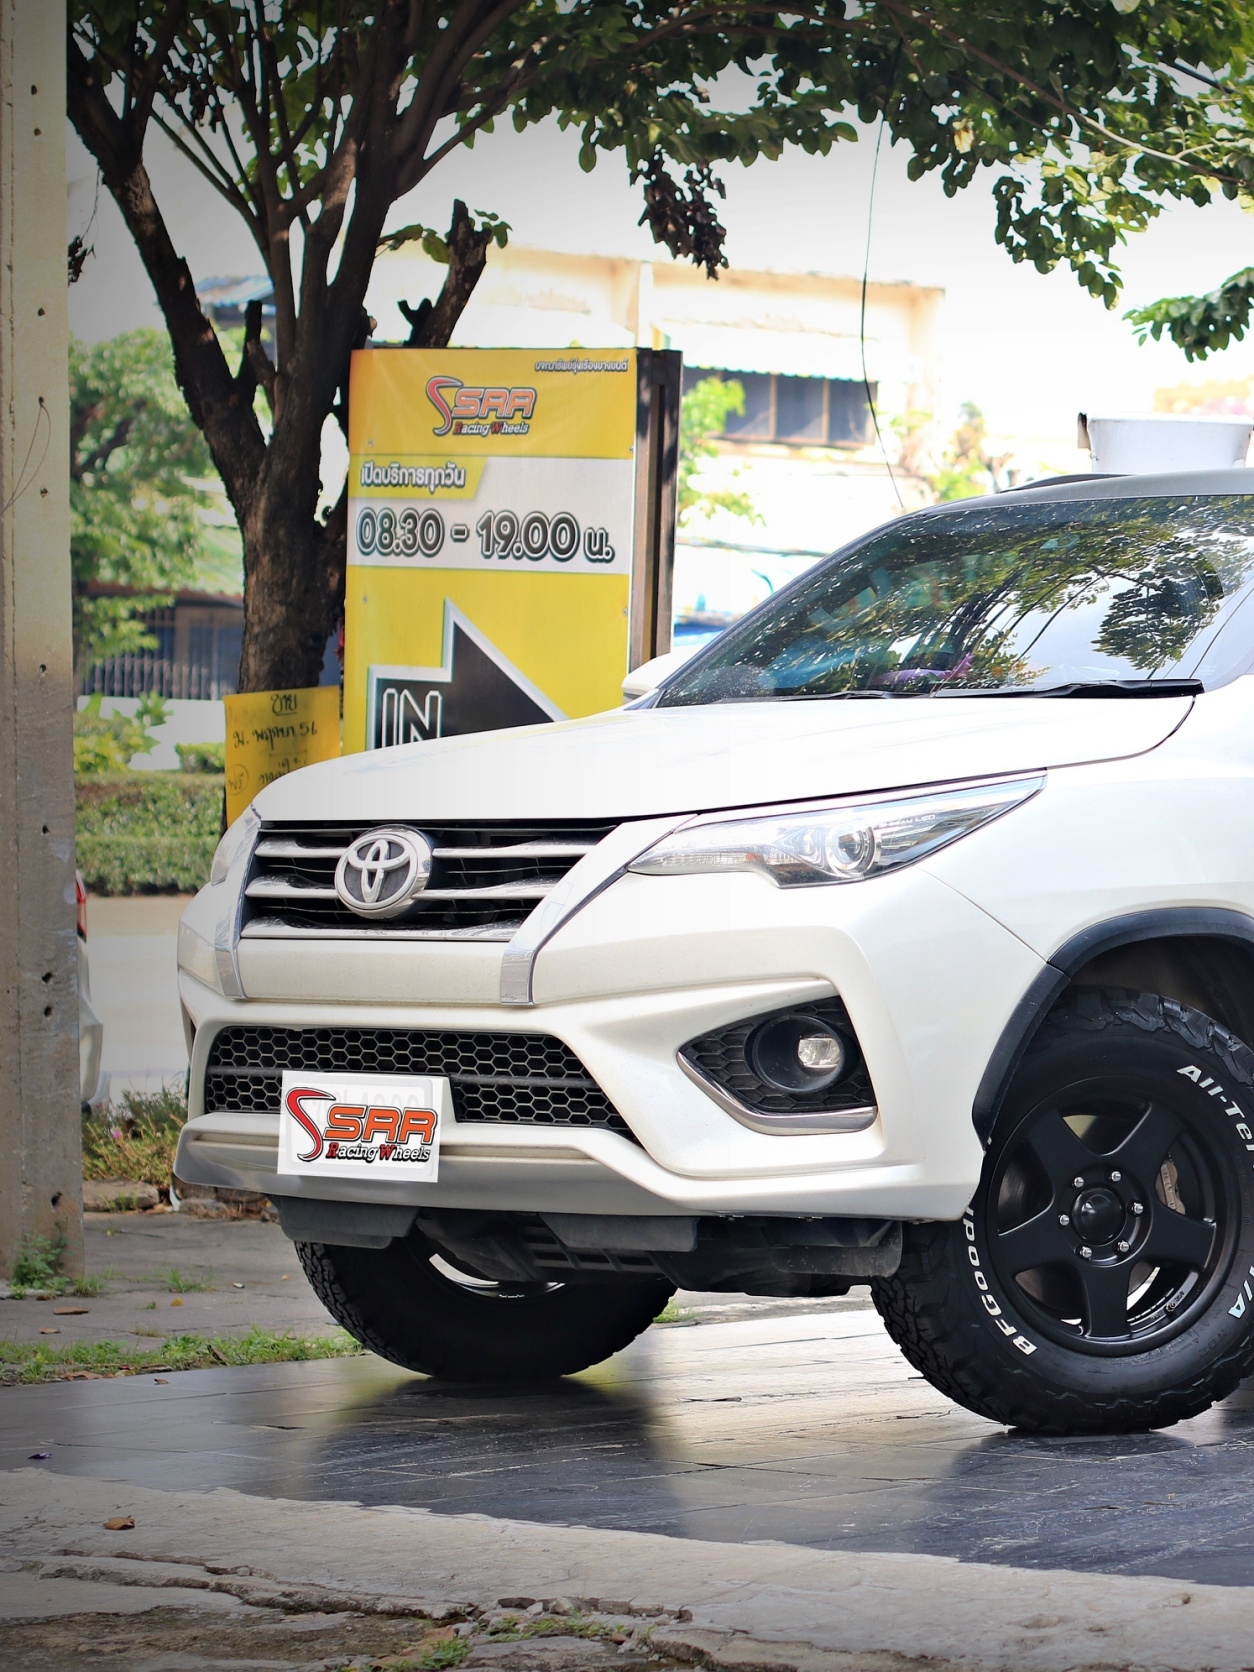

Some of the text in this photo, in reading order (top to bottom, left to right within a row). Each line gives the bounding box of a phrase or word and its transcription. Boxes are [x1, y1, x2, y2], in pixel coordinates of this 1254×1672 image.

[452, 420, 530, 437] Racing Wheels
[360, 460, 466, 495] เปิดบริการทุกวัน
[356, 506, 445, 558] 08.30
[475, 509, 580, 560] 19.00
[381, 687, 443, 747] IN
